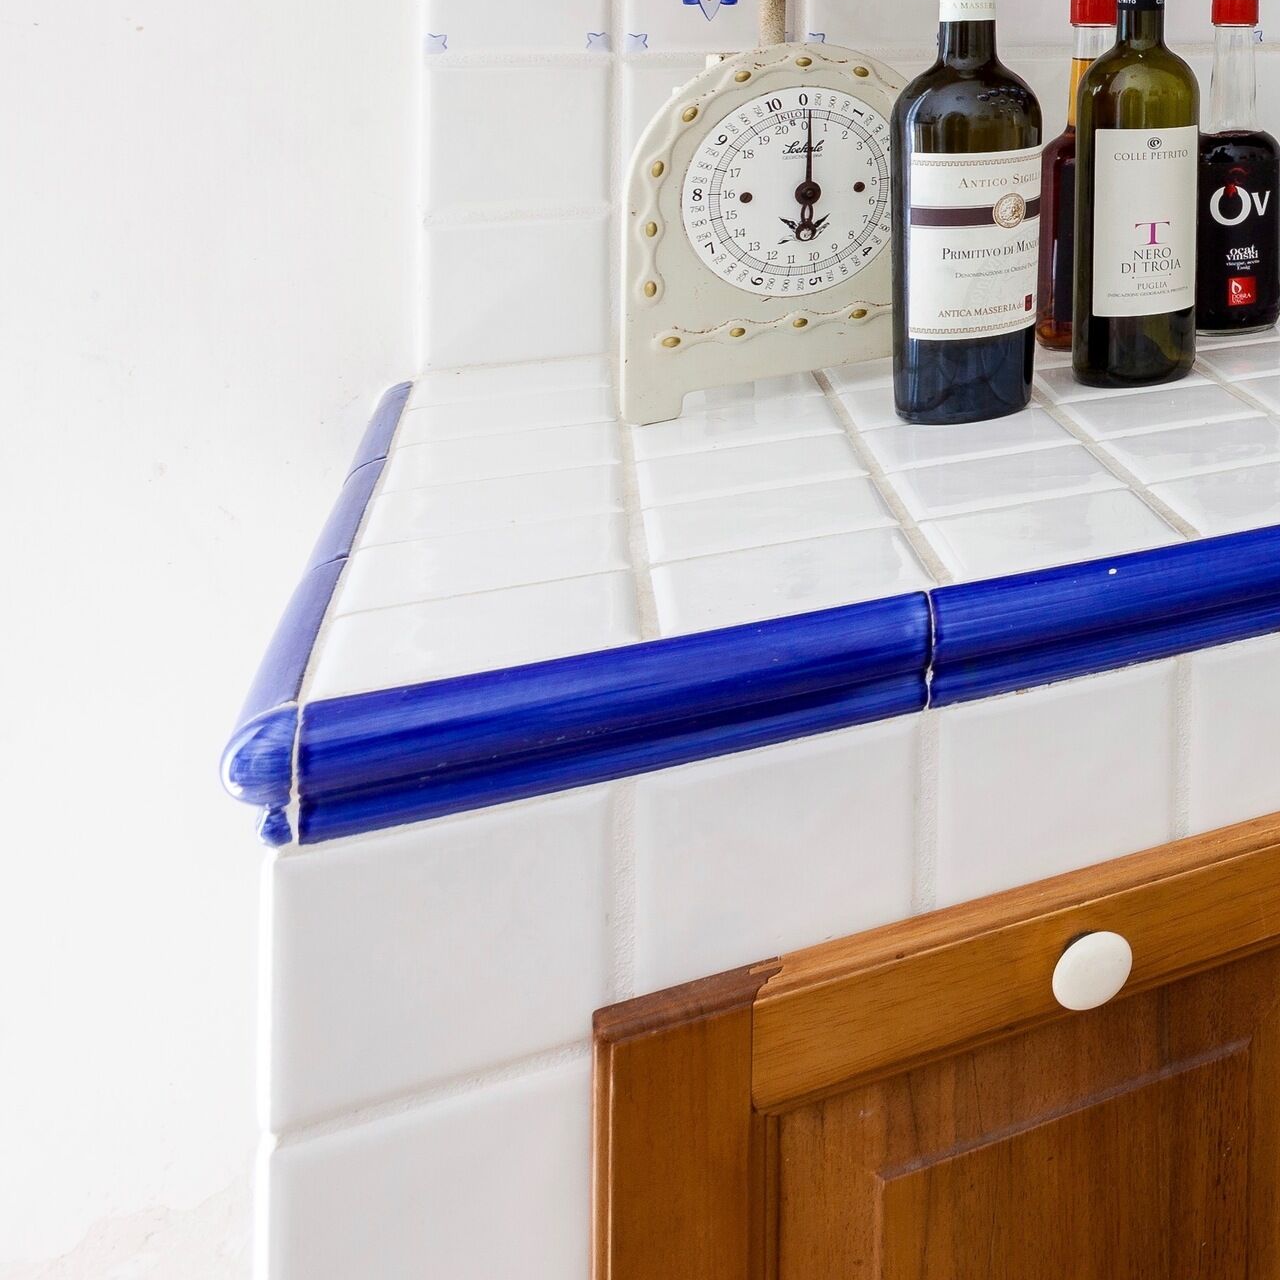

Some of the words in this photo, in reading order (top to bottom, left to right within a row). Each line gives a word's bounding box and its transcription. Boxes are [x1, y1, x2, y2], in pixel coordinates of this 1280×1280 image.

[798, 93, 808, 106] 0
[765, 98, 782, 114] 10
[780, 112, 802, 120] KILO
[852, 108, 864, 118] 1
[774, 125, 788, 136] 20
[801, 121, 808, 130] 0
[824, 123, 828, 132] 1
[714, 134, 728, 146] 9
[842, 130, 848, 140] 2
[758, 135, 770, 146] 19
[856, 142, 863, 151] 3
[705, 147, 720, 158] 750
[742, 149, 754, 160] 18
[1114, 152, 1147, 161] COLLE
[1150, 150, 1188, 160] PETRITO
[696, 162, 712, 171] 500
[866, 158, 873, 166] 4
[730, 168, 742, 178] 17
[870, 176, 878, 186] 5
[692, 188, 702, 202] 8
[723, 189, 736, 200] 16
[868, 196, 875, 205] 6
[726, 210, 738, 220] 15
[862, 214, 868, 224] 7
[691, 218, 708, 228] 500
[734, 228, 746, 238] 14
[848, 230, 854, 240] 8
[1134, 221, 1170, 246] T
[704, 242, 714, 254] 7
[748, 241, 760, 252] 13
[831, 242, 838, 252] 9
[862, 246, 873, 257] 4
[1230, 244, 1255, 256] ocat
[766, 250, 778, 261] 12
[808, 252, 820, 262] 10
[1134, 247, 1172, 260] NERO
[1226, 250, 1258, 260] vinski
[787, 255, 796, 264] 11
[1121, 262, 1136, 274] DI
[1142, 258, 1182, 272] TROIA
[808, 276, 822, 286] 5
[1137, 282, 1168, 290] PUGLIA
[938, 309, 972, 318] ANTICA
[974, 304, 1016, 317] MASSERIA
